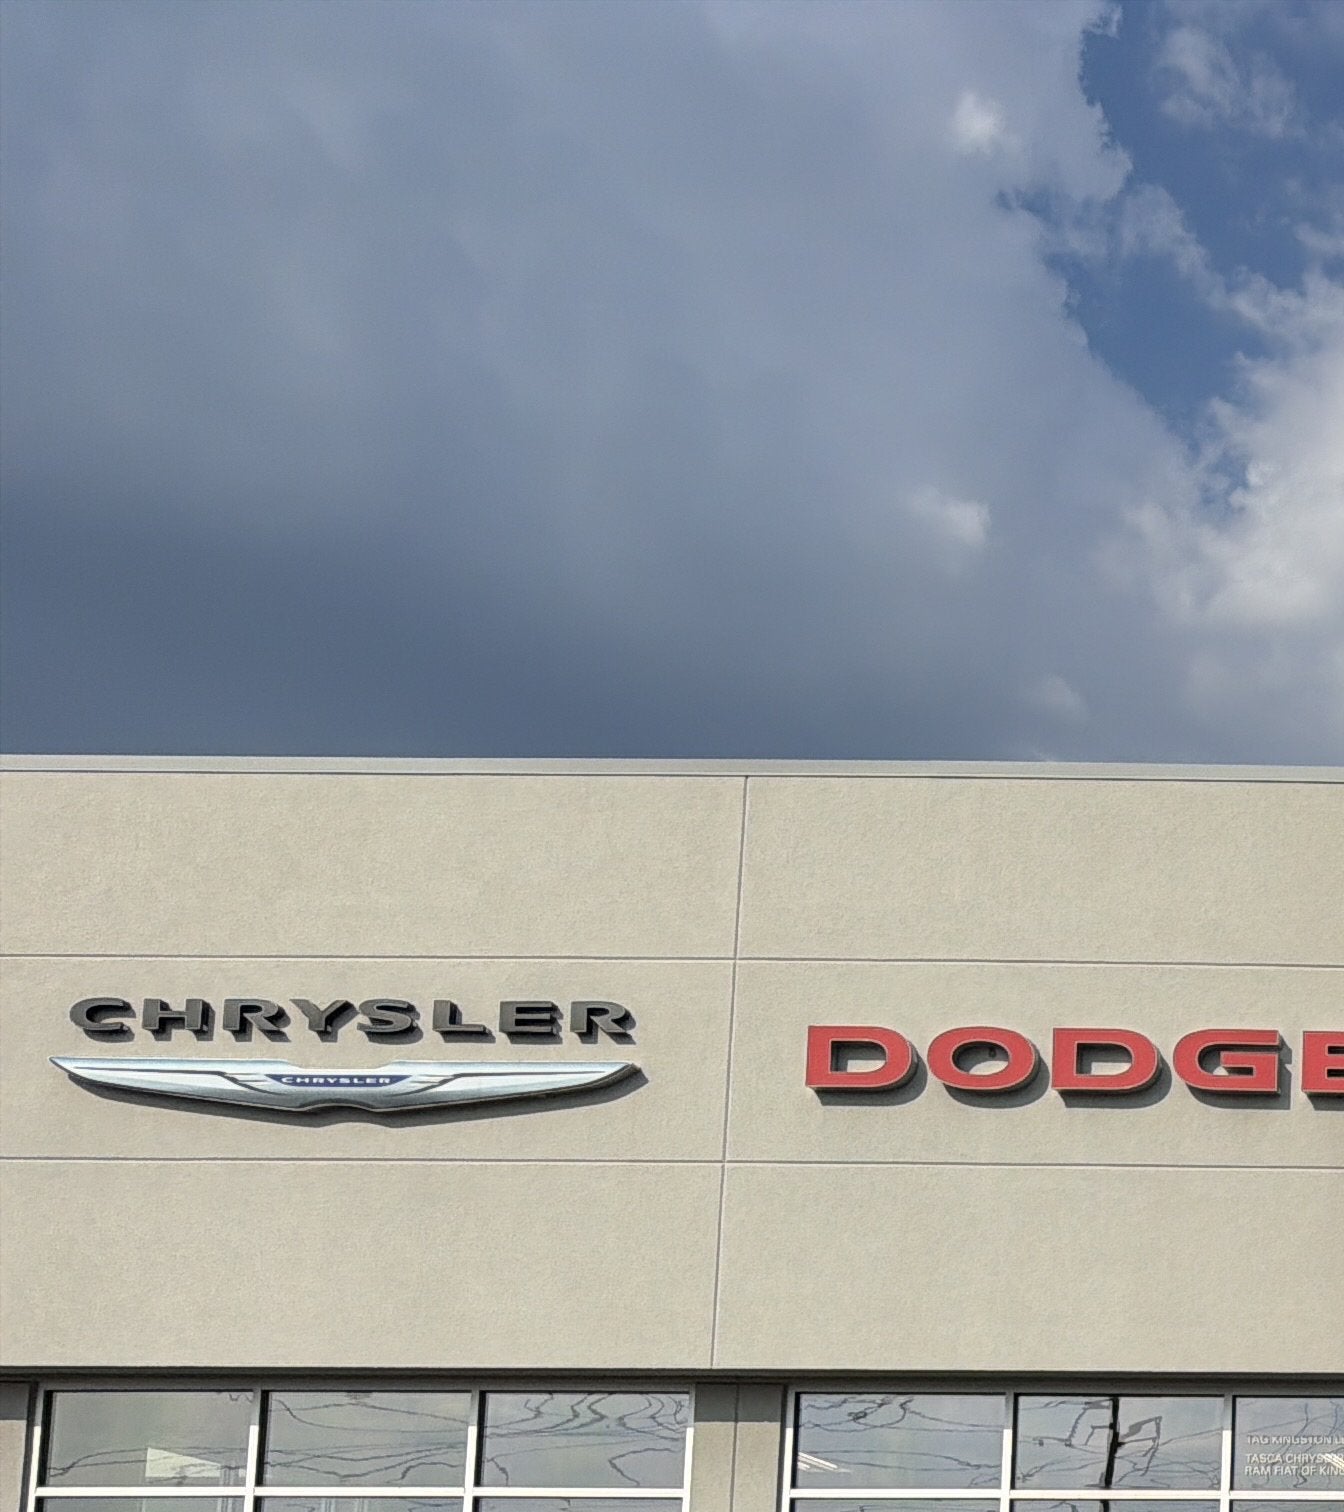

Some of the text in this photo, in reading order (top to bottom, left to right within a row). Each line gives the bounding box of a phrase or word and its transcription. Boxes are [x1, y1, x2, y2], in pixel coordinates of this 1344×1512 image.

[68, 997, 636, 1040] CHRYSLER
[281, 1076, 391, 1084] CHRYSLER
[1247, 1434, 1269, 1444] TAG
[1271, 1434, 1332, 1444] KINGSTON
[1246, 1453, 1283, 1464] TASCA
[1245, 1465, 1271, 1476] RAM
[1274, 1465, 1298, 1476] FIAT
[1301, 1465, 1317, 1476] OF
